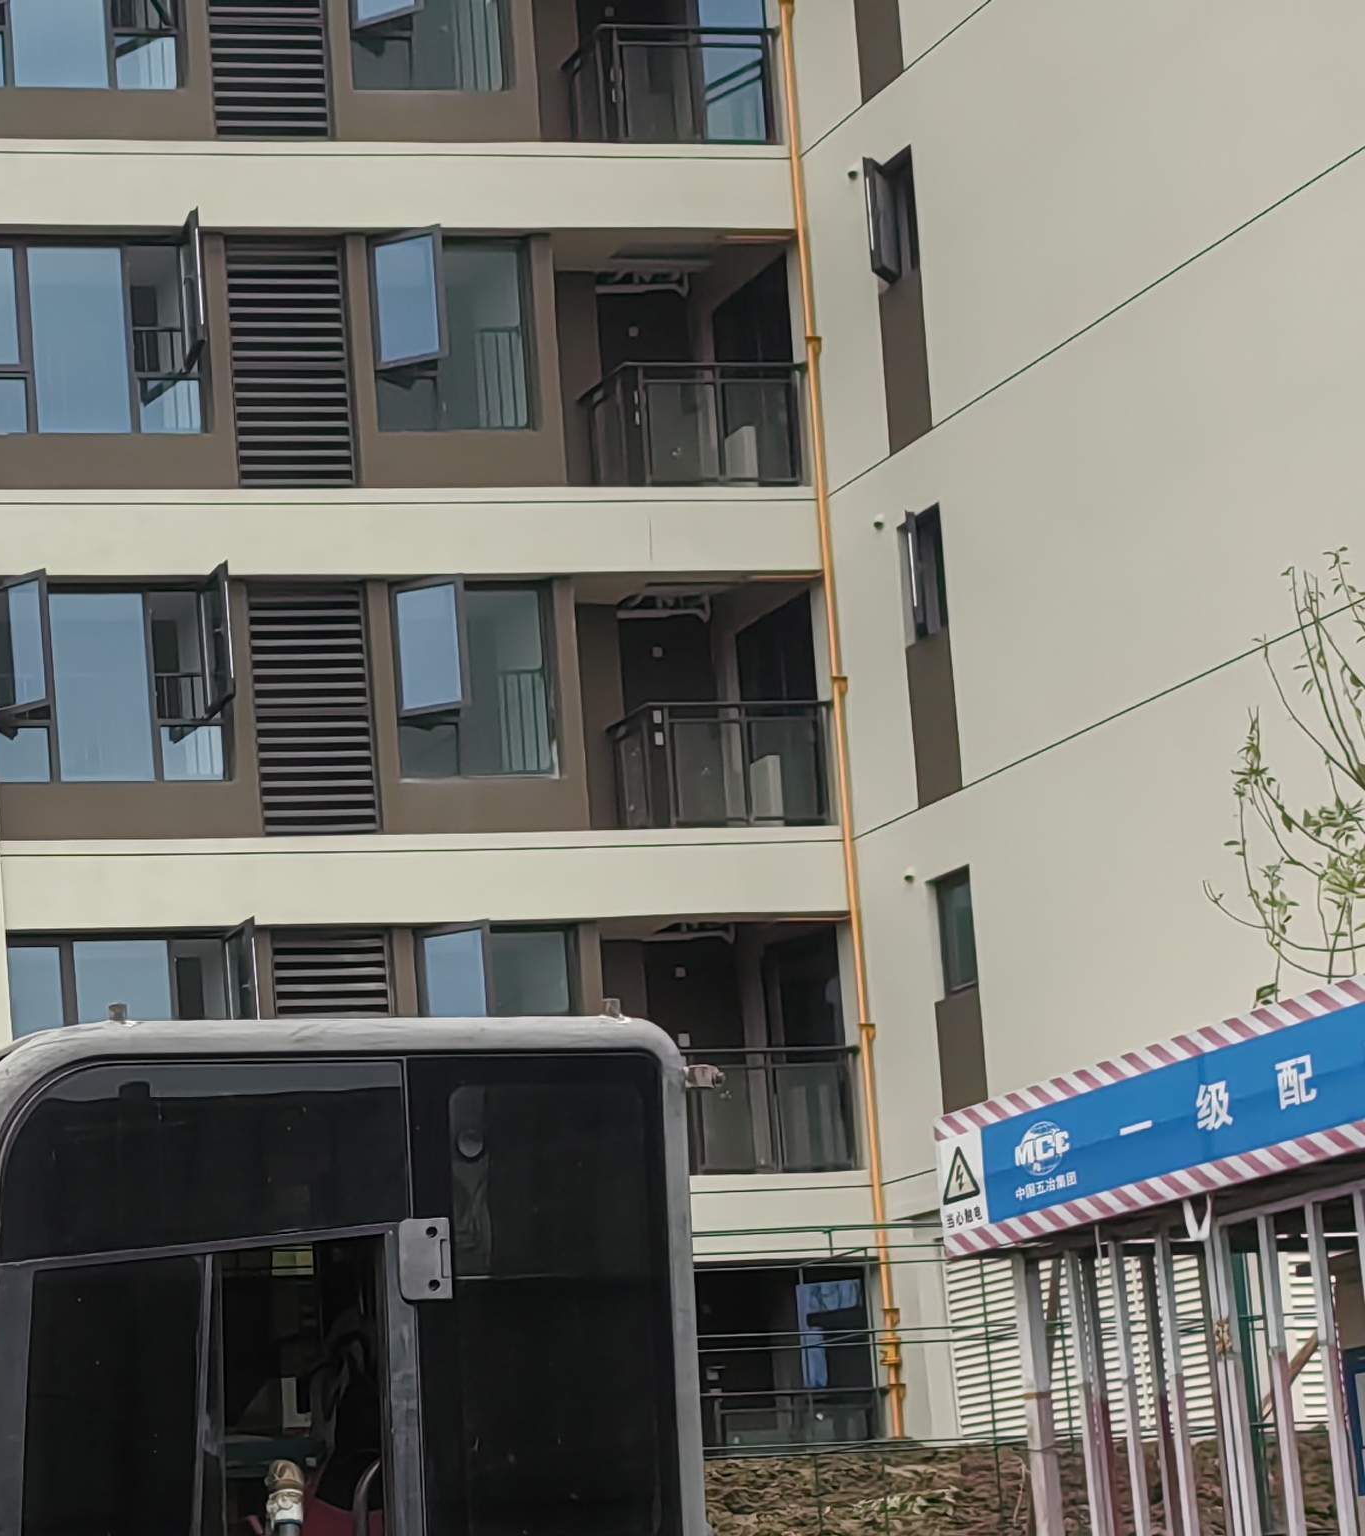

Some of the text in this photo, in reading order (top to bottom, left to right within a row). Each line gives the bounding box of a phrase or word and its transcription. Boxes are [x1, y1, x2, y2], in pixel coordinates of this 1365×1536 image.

[1119, 1054, 1317, 1136] 一级配
[1014, 1129, 1070, 1166] MCC
[1015, 1170, 1077, 1200] 中国五冶集团
